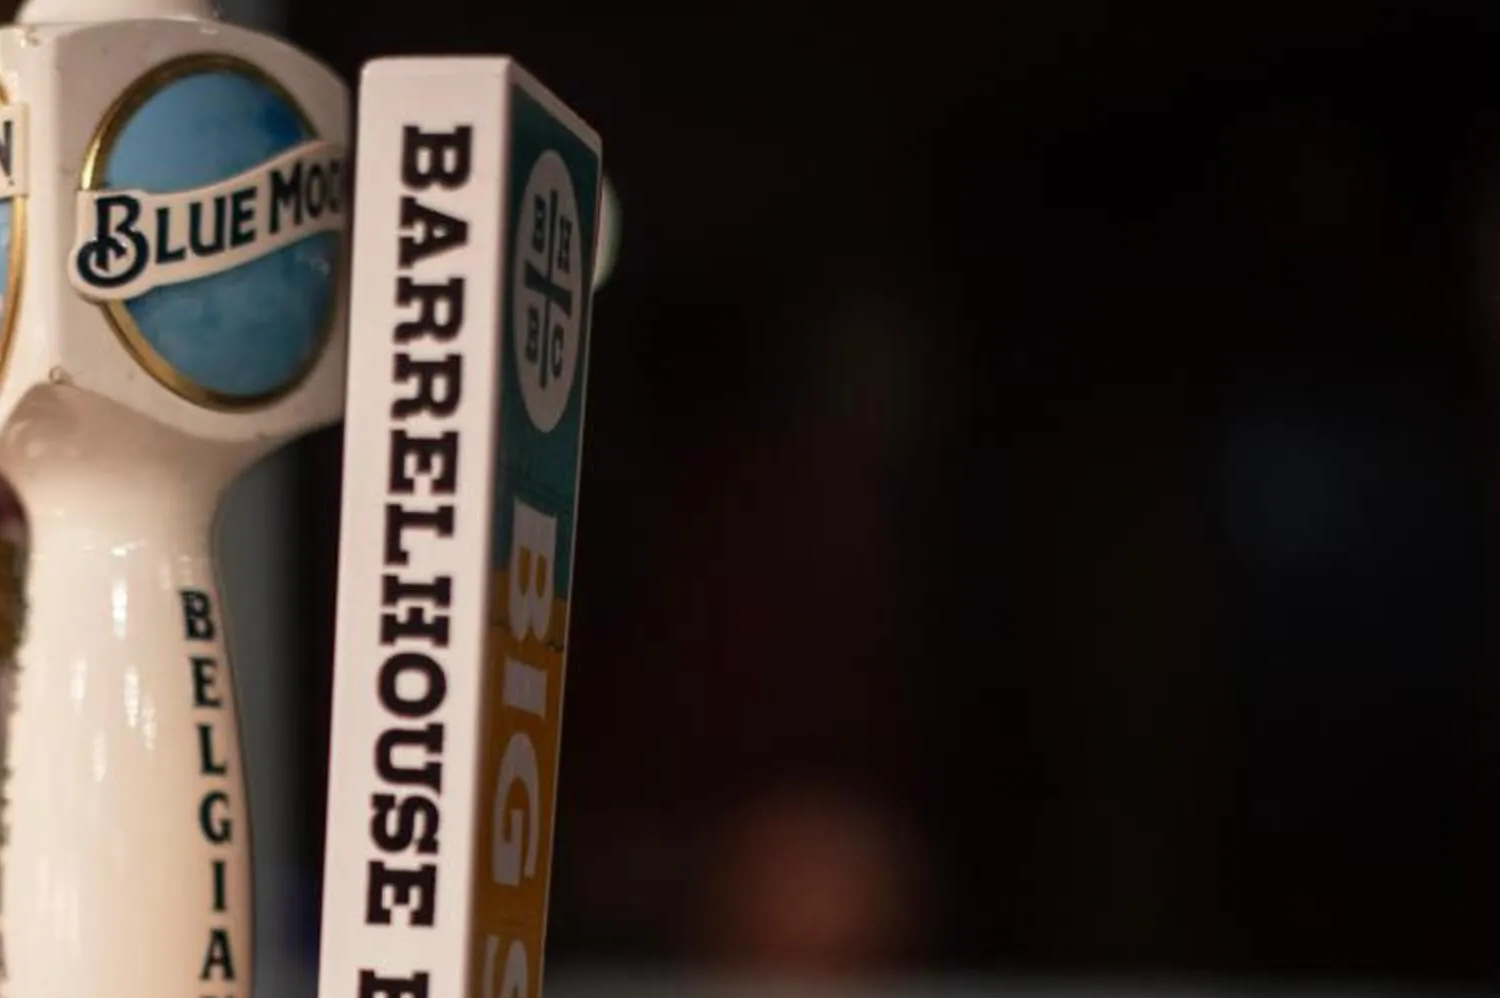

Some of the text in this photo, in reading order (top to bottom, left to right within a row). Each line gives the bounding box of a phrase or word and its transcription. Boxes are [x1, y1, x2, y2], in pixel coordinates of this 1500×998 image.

[76, 186, 257, 289] BLUE
[366, 124, 473, 927] BARRELHOUSE
[492, 497, 558, 887] BIG
